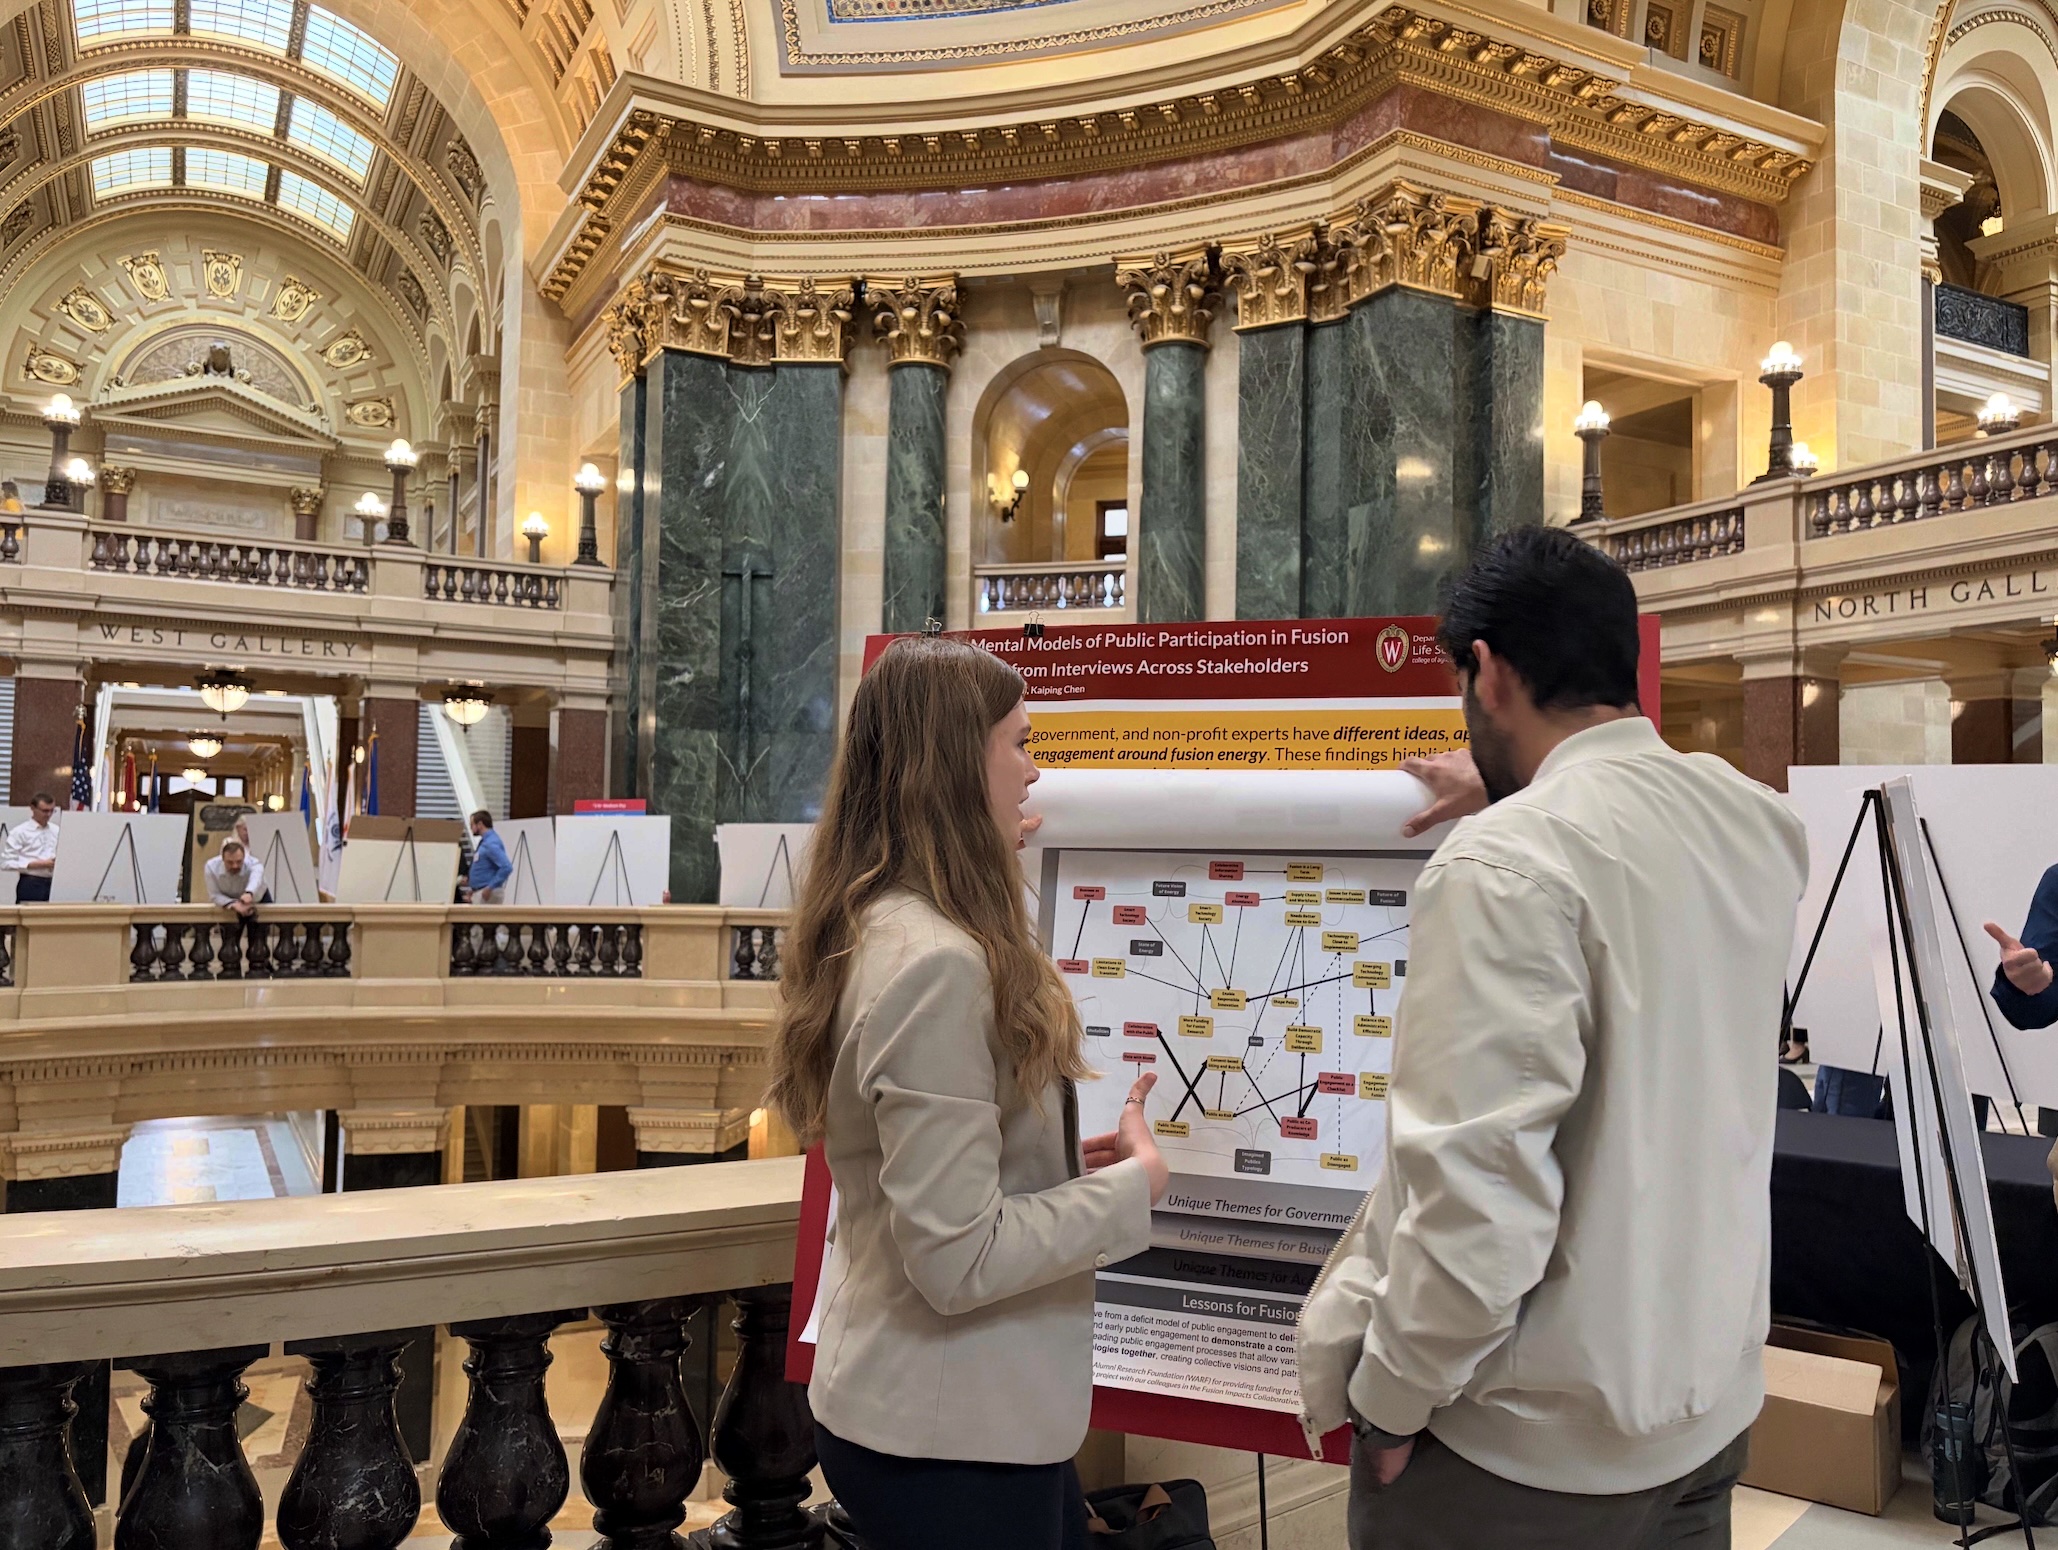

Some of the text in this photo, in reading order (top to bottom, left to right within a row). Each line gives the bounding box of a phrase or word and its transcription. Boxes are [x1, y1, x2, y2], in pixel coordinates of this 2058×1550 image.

[1815, 570, 2050, 623] NORTH GALL
[99, 623, 358, 657] WEST GALLERY
[971, 628, 1349, 653] Mental Models of Public Participation in Fusion
[1384, 641, 1402, 663] W
[1413, 645, 1432, 655] Life
[1012, 658, 1309, 678] from Interviews Across Stakeholders
[1412, 657, 1431, 665] college
[1031, 685, 1063, 696] Kaiping
[1063, 685, 1085, 694] Chen
[1032, 727, 1119, 743] government,
[1123, 727, 1149, 740] and
[1153, 726, 1228, 743] non-profit
[1231, 728, 1289, 743] experts
[1293, 727, 1330, 740] have
[1333, 726, 1400, 743] different
[1404, 726, 1449, 742] ideas,
[1033, 748, 1115, 763] engagement
[1118, 747, 1168, 760] around
[1171, 747, 1216, 763] fusion
[1218, 749, 1270, 764] energy.
[1275, 747, 1322, 760] These
[1325, 747, 1388, 764] findings
[1168, 1194, 1354, 1225] Unique Themes for Governme
[1179, 1229, 1224, 1245] Unique
[1227, 1234, 1275, 1250] Themes
[1277, 1239, 1297, 1252] for
[1173, 1258, 1217, 1276] Unique
[1220, 1264, 1268, 1281] Themes
[1270, 1270, 1287, 1284] for
[1182, 1294, 1233, 1313] Lessons
[1236, 1301, 1256, 1316] for
[1104, 1311, 1121, 1320] from
[1131, 1314, 1154, 1324] deficit
[1155, 1318, 1179, 1328] model
[1182, 1320, 1190, 1329] of
[1191, 1321, 1215, 1332] public
[1217, 1325, 1267, 1339] engagement
[1269, 1332, 1277, 1340] to
[1105, 1323, 1124, 1334] early
[1125, 1326, 1149, 1335] public
[1150, 1328, 1200, 1342] engagement
[1202, 1335, 1209, 1343] to
[1211, 1336, 1265, 1350] demonstrate
[1275, 1345, 1296, 1354] com
[1120, 1336, 1143, 1346] public
[1145, 1339, 1194, 1353] engagement
[1196, 1346, 1237, 1358] processes
[1239, 1351, 1255, 1361] that
[1257, 1354, 1278, 1363] allow
[1121, 1347, 1158, 1360] together,
[1160, 1353, 1192, 1365] creating
[1194, 1357, 1231, 1369] collective
[1233, 1362, 1262, 1373] visions
[1263, 1367, 1279, 1376] and
[1093, 1361, 1116, 1370] Alumni
[1117, 1364, 1146, 1375] Research
[1147, 1368, 1184, 1380] Foundation
[1185, 1374, 1211, 1383] (WARF)
[1222, 1380, 1254, 1392] providing
[1255, 1384, 1281, 1395] funding
[1282, 1388, 1292, 1396] for
[1095, 1372, 1118, 1381] project
[1147, 1379, 1180, 1389] colleagues
[1190, 1384, 1200, 1392] the
[1201, 1386, 1224, 1395] Fusion
[1225, 1389, 1252, 1399] Impacts
[1253, 1393, 1300, 1406] Collaborative.
